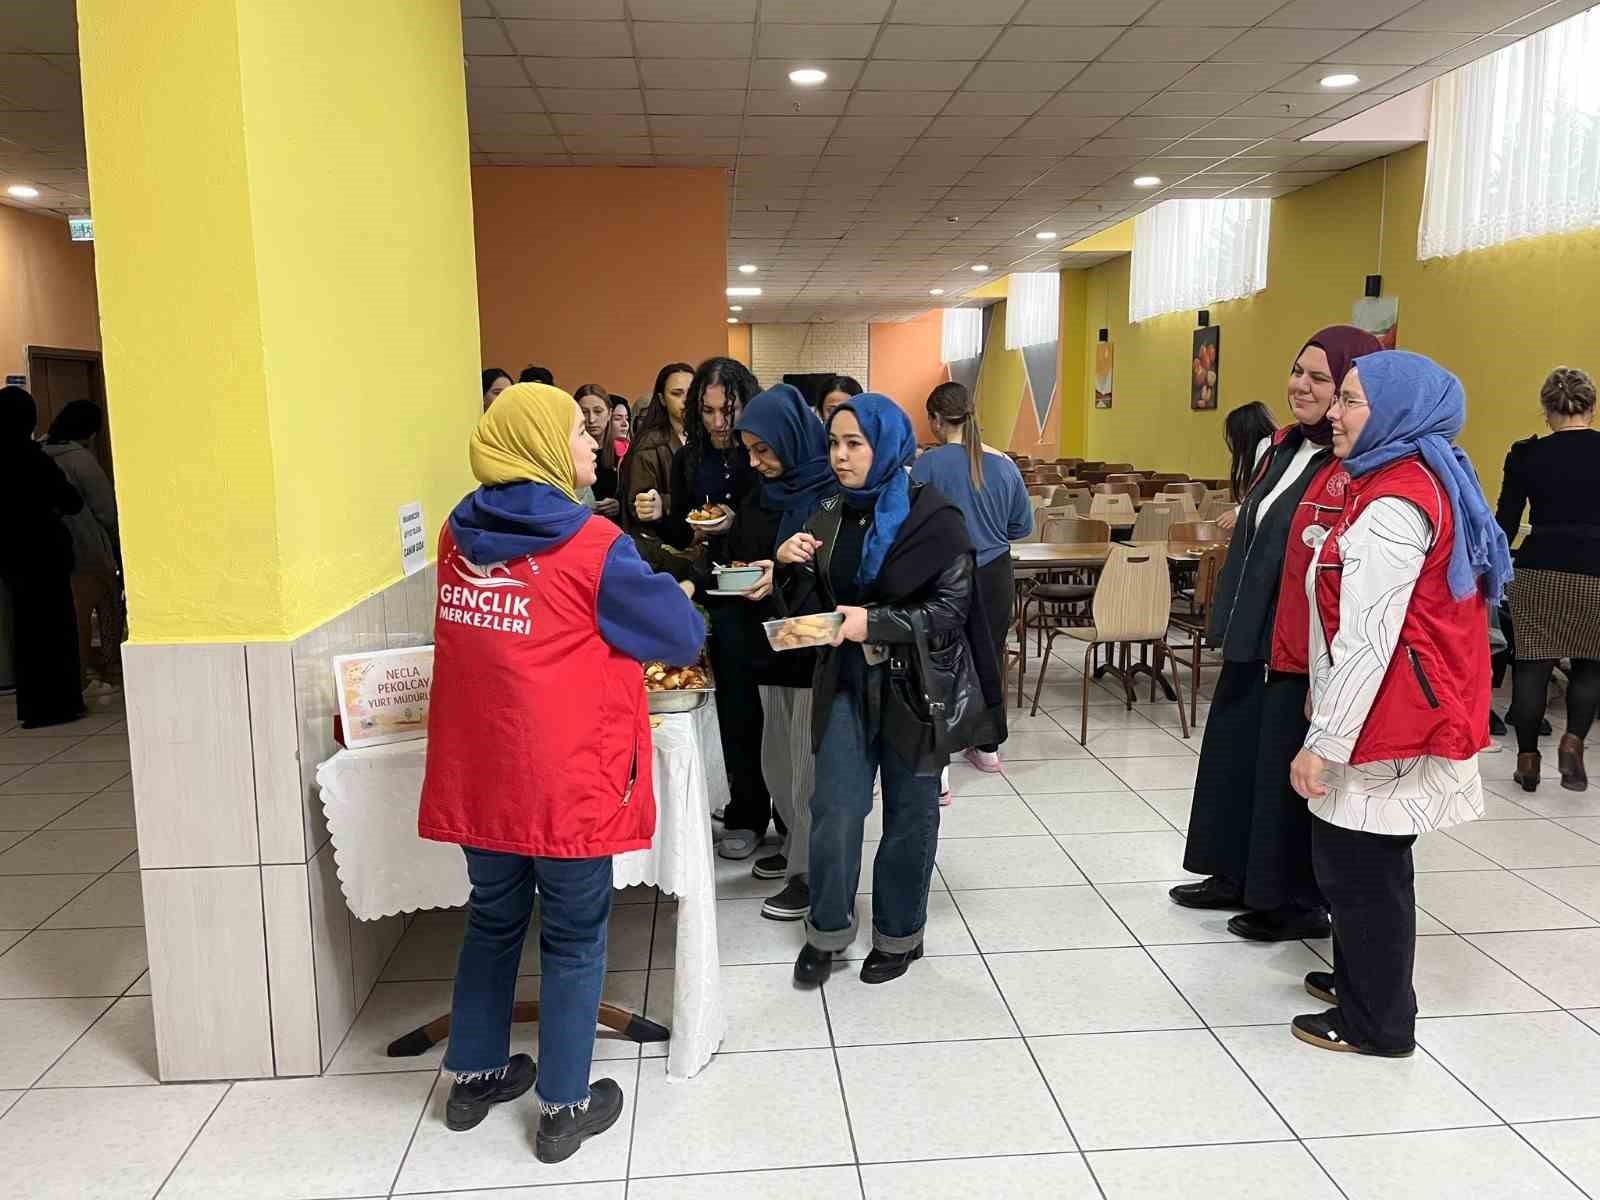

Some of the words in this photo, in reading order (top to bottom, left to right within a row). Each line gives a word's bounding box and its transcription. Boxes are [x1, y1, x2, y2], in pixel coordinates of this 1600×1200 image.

[386, 666, 420, 680] NECLA
[377, 678, 430, 694] PEKOLCAY
[368, 697, 390, 708] YURT
